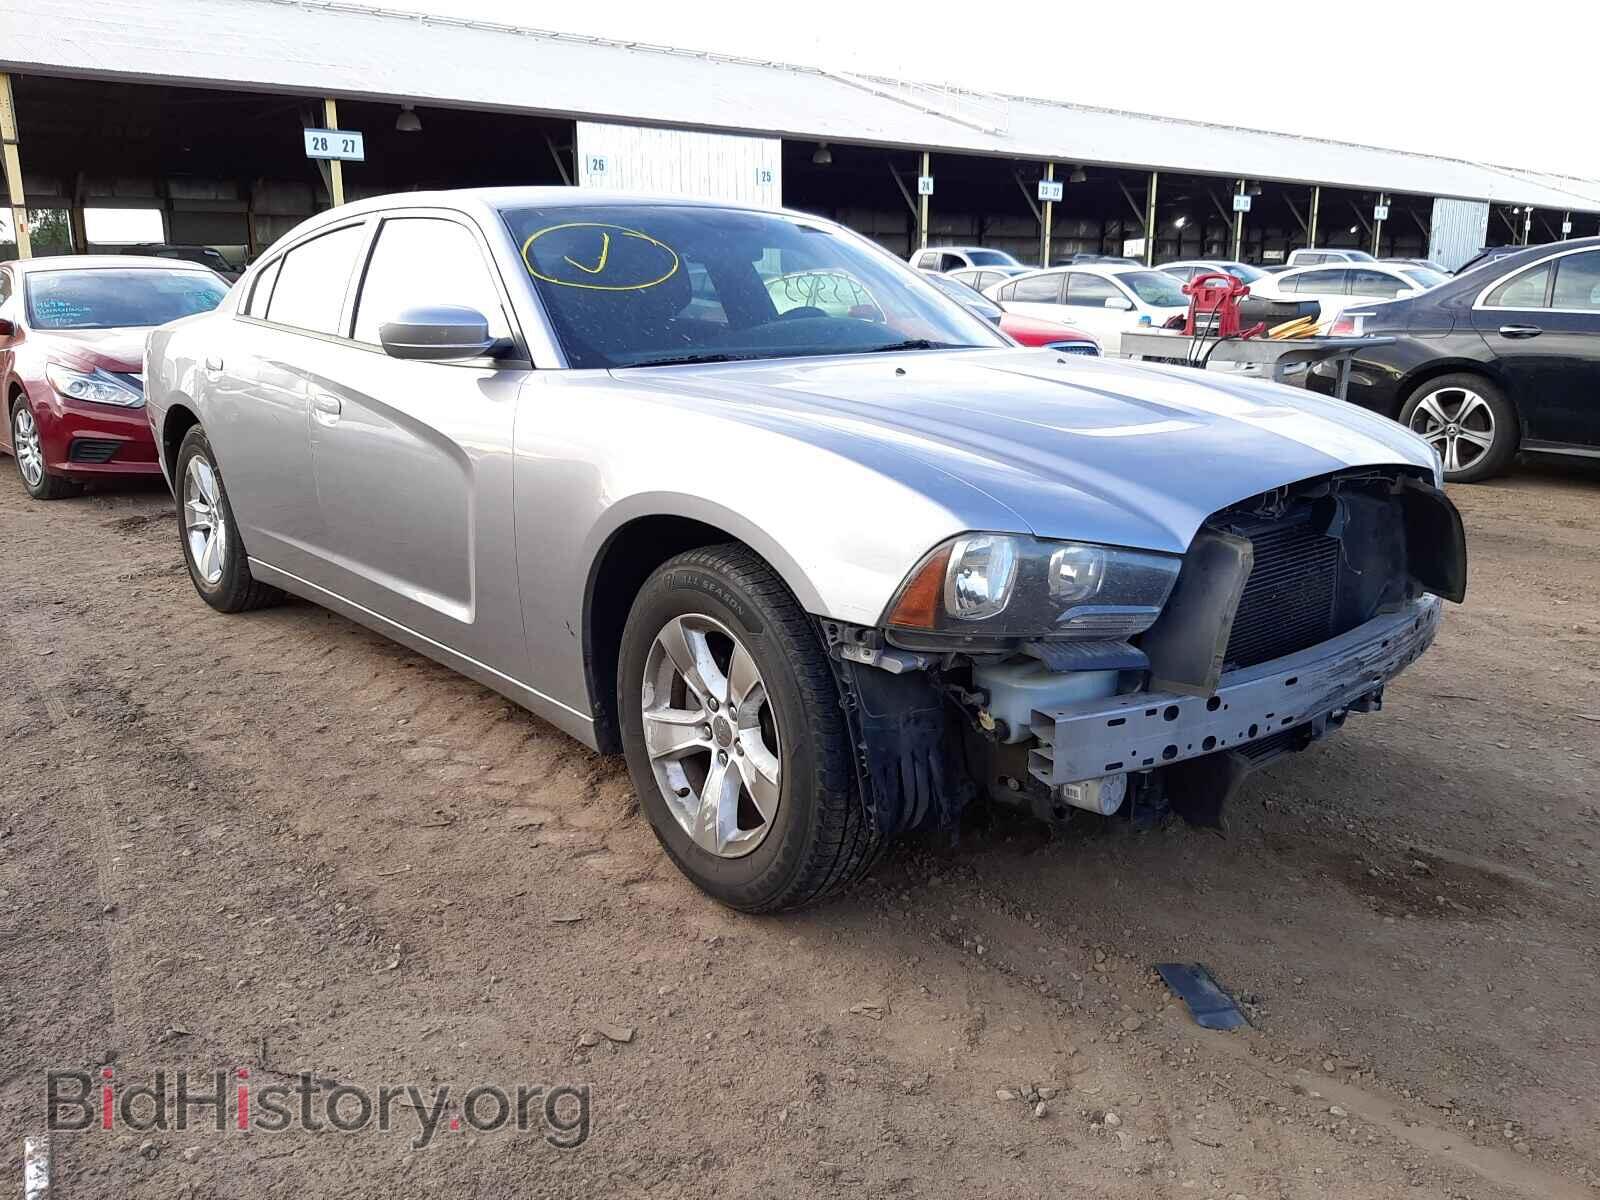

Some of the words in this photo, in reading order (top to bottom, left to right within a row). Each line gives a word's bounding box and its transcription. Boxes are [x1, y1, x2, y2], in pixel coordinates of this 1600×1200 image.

[312, 136, 328, 151] 28
[342, 139, 355, 153] 27
[592, 158, 604, 171] 26
[761, 170, 771, 182] 25
[702, 580, 744, 616] SEASON
